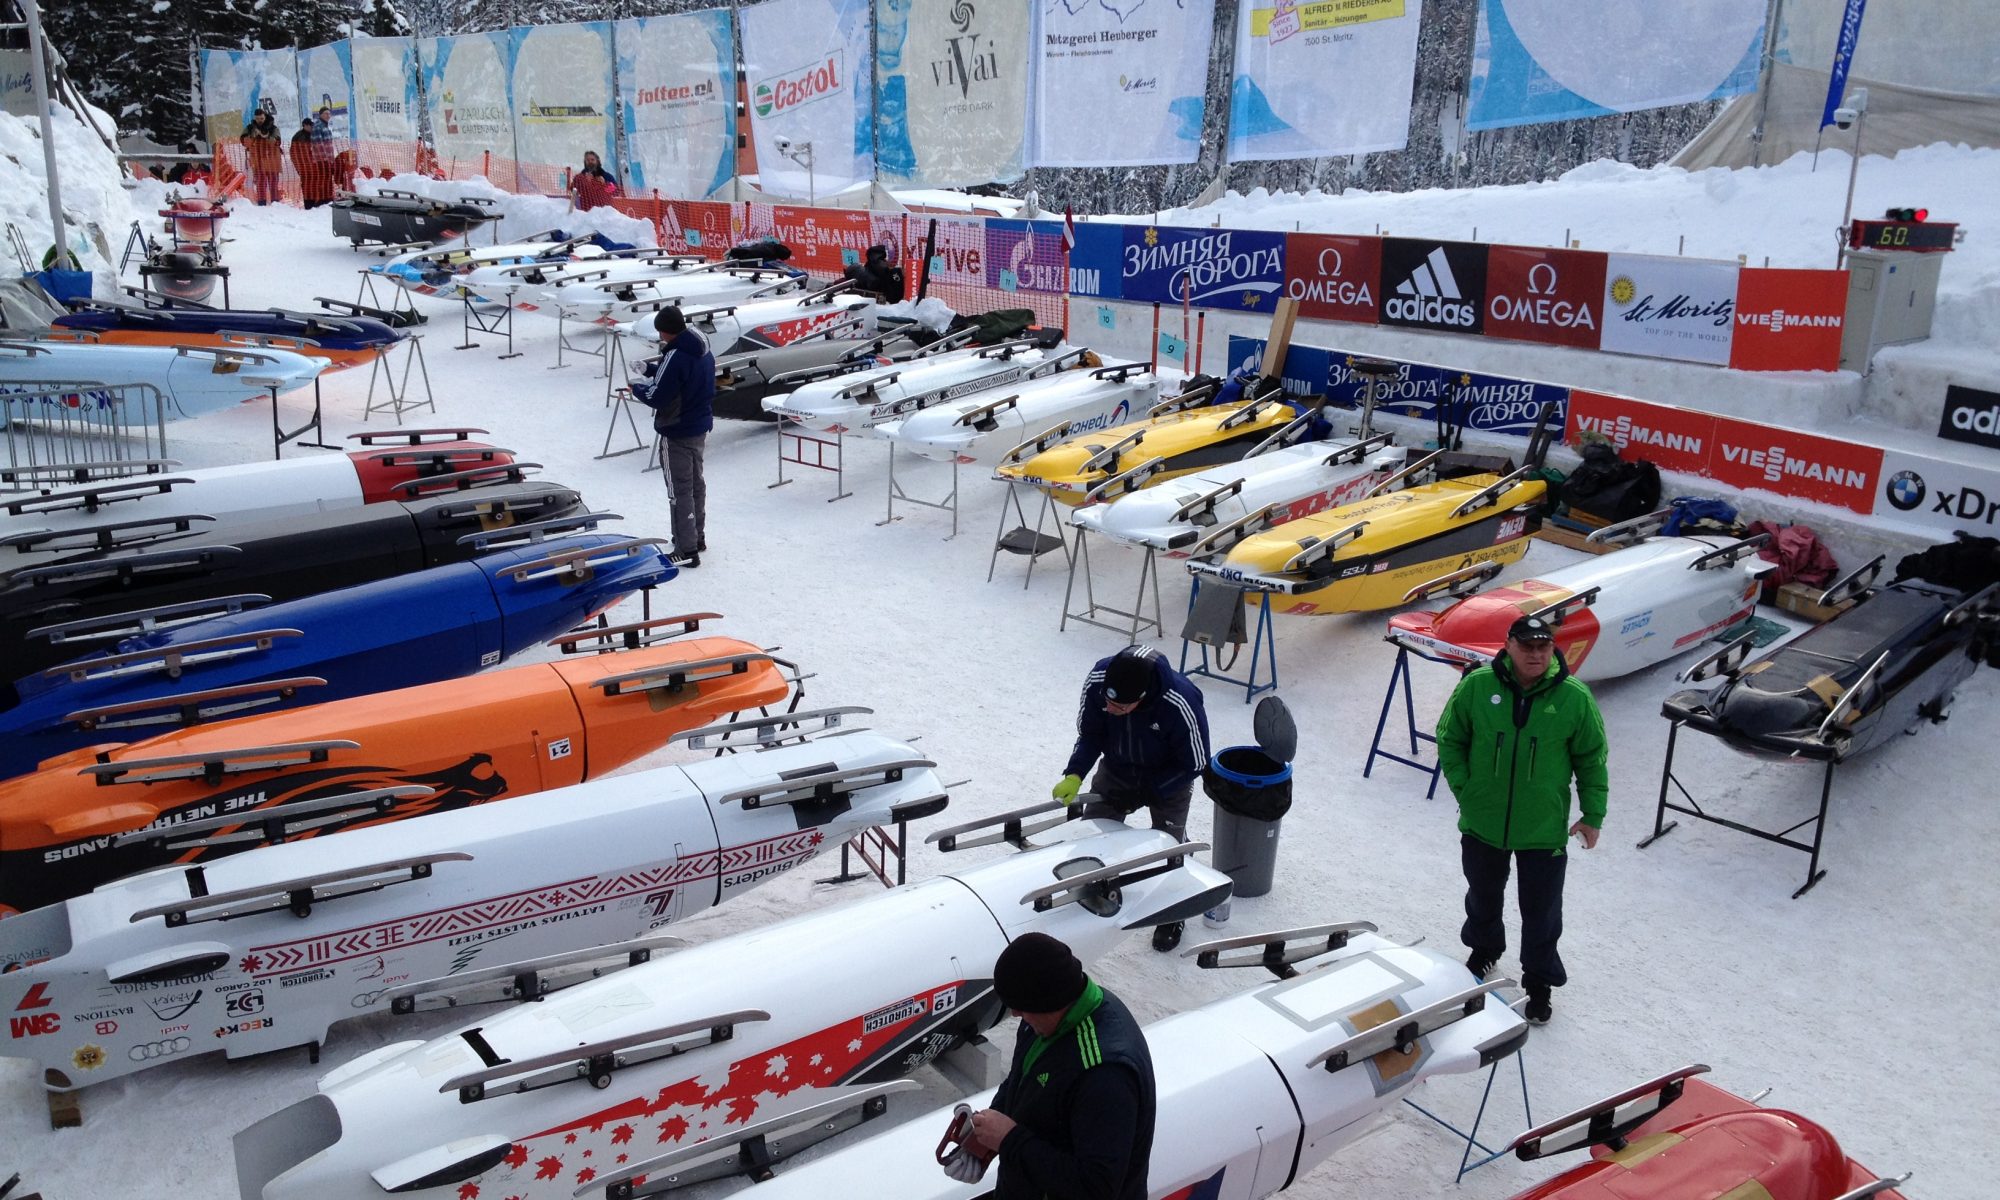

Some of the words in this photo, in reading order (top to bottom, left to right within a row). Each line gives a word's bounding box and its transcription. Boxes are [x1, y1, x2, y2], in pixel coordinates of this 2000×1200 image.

[1304, 5, 1333, 15] ALFRED
[1100, 29, 1158, 42] Heuberger
[1276, 25, 1293, 37] 1927
[774, 58, 839, 110] Castrol
[375, 101, 401, 114] ENERGIE
[969, 102, 994, 113] DARK
[776, 218, 869, 256] VIESSMANN
[1123, 232, 1232, 278] ЗИМНЯЯ
[1173, 247, 1282, 296] ДОРОГА
[1289, 278, 1374, 307] OMEGA
[1386, 293, 1475, 327] adidas
[1491, 295, 1595, 331] OMEGA
[1620, 294, 1653, 325] St.
[1649, 294, 1736, 327] Moritz
[1737, 309, 1841, 332] VIESSMANN
[1645, 327, 1658, 335] TOP
[1677, 331, 1694, 339] THE
[1698, 333, 1728, 342] WORLD
[1166, 344, 1175, 354] 9
[1576, 415, 1702, 455] VIESSMANN
[1721, 446, 1866, 490] VIESSMANN
[1497, 515, 1526, 539] REWE
[552, 744, 570, 757] 21
[223, 791, 267, 812] THE
[724, 861, 793, 888] Binders
[541, 905, 605, 925] LATVIJAS
[487, 921, 537, 937] VALSTS
[215, 982, 250, 993] CARGO
[281, 973, 323, 988] EUROTECH
[383, 974, 409, 984] Audi
[934, 995, 954, 1011] 19
[74, 1006, 134, 1022] BASTIONS
[865, 1006, 913, 1033] EUROTECH
[10, 1013, 60, 1039] 3M
[161, 1024, 190, 1036] Audi
